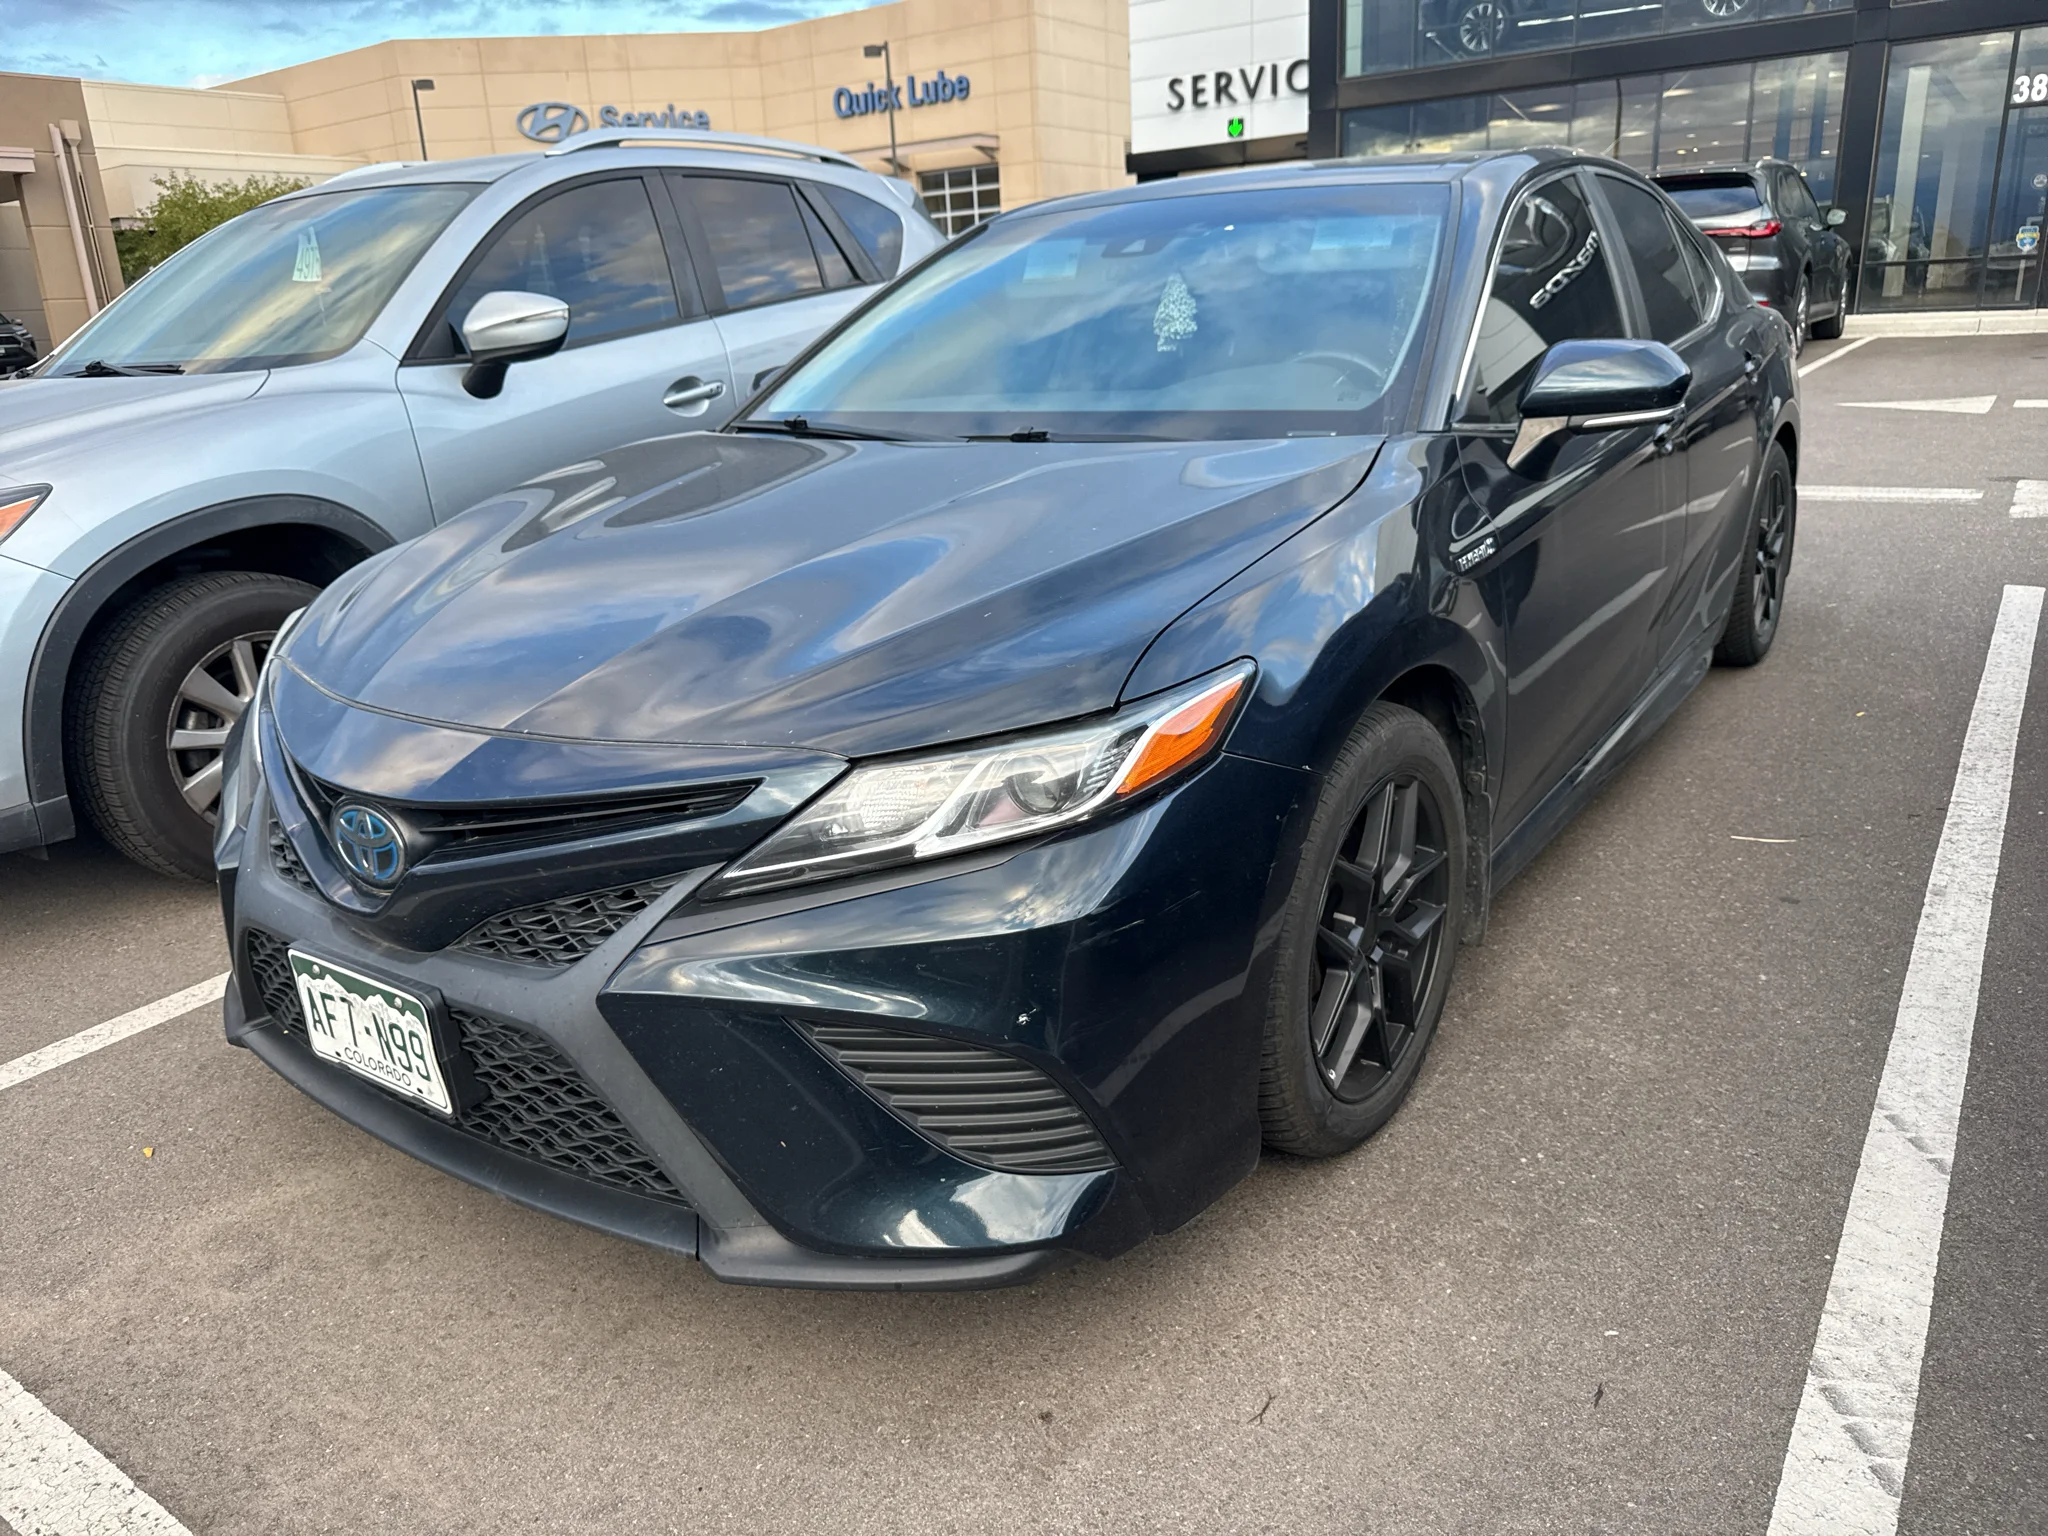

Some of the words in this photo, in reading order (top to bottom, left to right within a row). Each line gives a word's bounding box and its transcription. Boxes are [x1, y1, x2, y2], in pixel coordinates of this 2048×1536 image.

[833, 80, 902, 119] Quick
[907, 70, 970, 107] Lube
[2013, 73, 2048, 103] 38
[599, 103, 710, 131] Service
[344, 1046, 412, 1087] COLORADO
